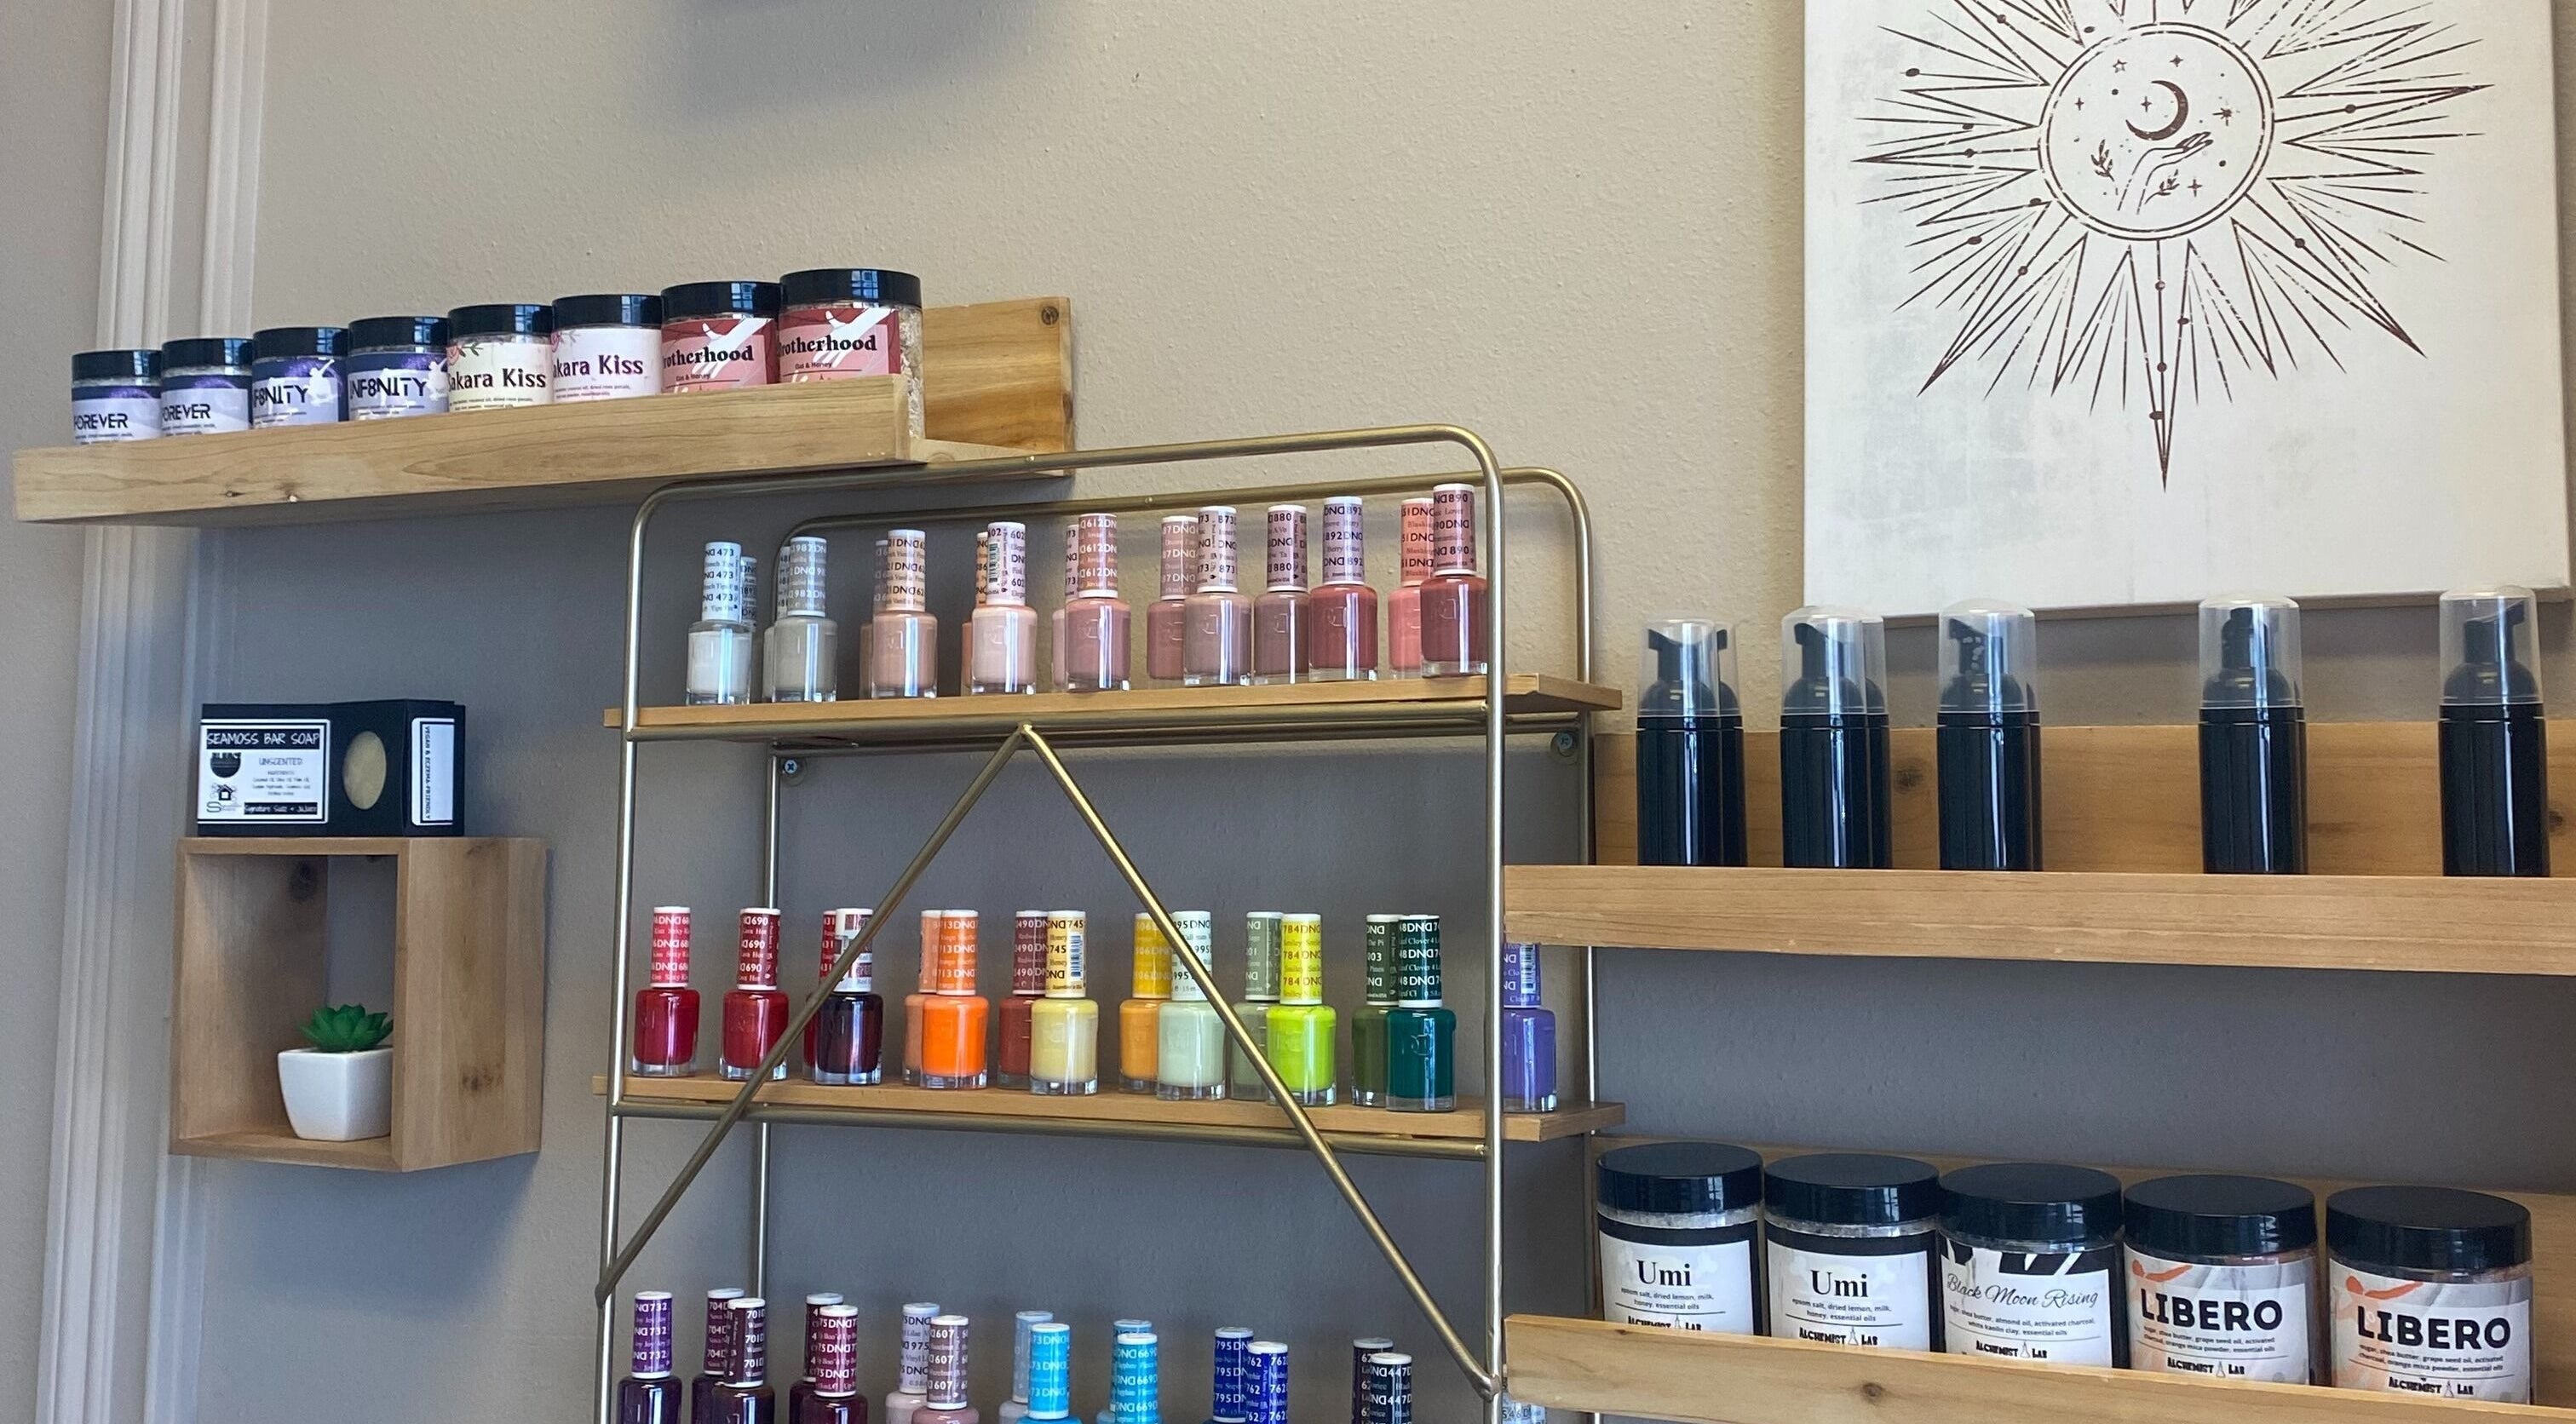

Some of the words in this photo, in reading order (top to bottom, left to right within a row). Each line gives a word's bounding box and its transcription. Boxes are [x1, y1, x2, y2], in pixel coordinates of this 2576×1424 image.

[662, 345, 754, 368] rotherhood
[554, 358, 591, 378] akara
[599, 354, 644, 375] Kiss
[503, 368, 547, 388] Kiss
[1449, 494, 1468, 502] 890
[1450, 546, 1469, 554] 890
[207, 732, 259, 745] SEAMOSS
[264, 732, 285, 744] BAR
[290, 732, 319, 745] SOAP
[751, 916, 769, 926] 690
[1067, 920, 1084, 928] 745
[1284, 925, 1300, 933] 784
[1407, 922, 1433, 933] DND
[749, 939, 765, 949] 690
[1049, 945, 1067, 953] 745
[1408, 949, 1433, 958] DND
[1284, 951, 1299, 960] 784
[745, 963, 762, 973] 690
[1410, 976, 1435, 985] DND
[1636, 1260, 1692, 1286] Umi
[1810, 1269, 1869, 1298] Umi
[1947, 1272, 1982, 1300] Black
[1985, 1284, 2038, 1306] Moon
[2042, 1289, 2099, 1309] Rising
[650, 1303, 667, 1312] 732
[2141, 1288, 2283, 1331] LIBERO
[650, 1327, 667, 1335] 732
[2357, 1306, 2511, 1351] LIBERO
[936, 1329, 954, 1338] 607
[1799, 1327, 1847, 1345] ALCHEMIST
[1861, 1334, 1878, 1346] LAB
[745, 1335, 759, 1343] 701
[1216, 1341, 1232, 1350] 795
[1976, 1340, 2018, 1358] ALCHEMIST
[2032, 1348, 2047, 1358] LAB
[649, 1350, 667, 1359] 732
[744, 1359, 758, 1368] 701
[935, 1356, 954, 1364] 607
[2167, 1357, 2214, 1374] ALCHEMIST
[2228, 1364, 2245, 1375] LAB
[1216, 1367, 1231, 1376] 795
[1389, 1367, 1407, 1376] 447
[934, 1381, 952, 1390] 607
[1270, 1384, 1285, 1393] 762
[2389, 1376, 2442, 1393] ALCHEMIST
[2457, 1384, 2474, 1395] LAB
[1216, 1393, 1231, 1403] 795
[1388, 1395, 1406, 1404] 447
[1269, 1411, 1285, 1421] 762
